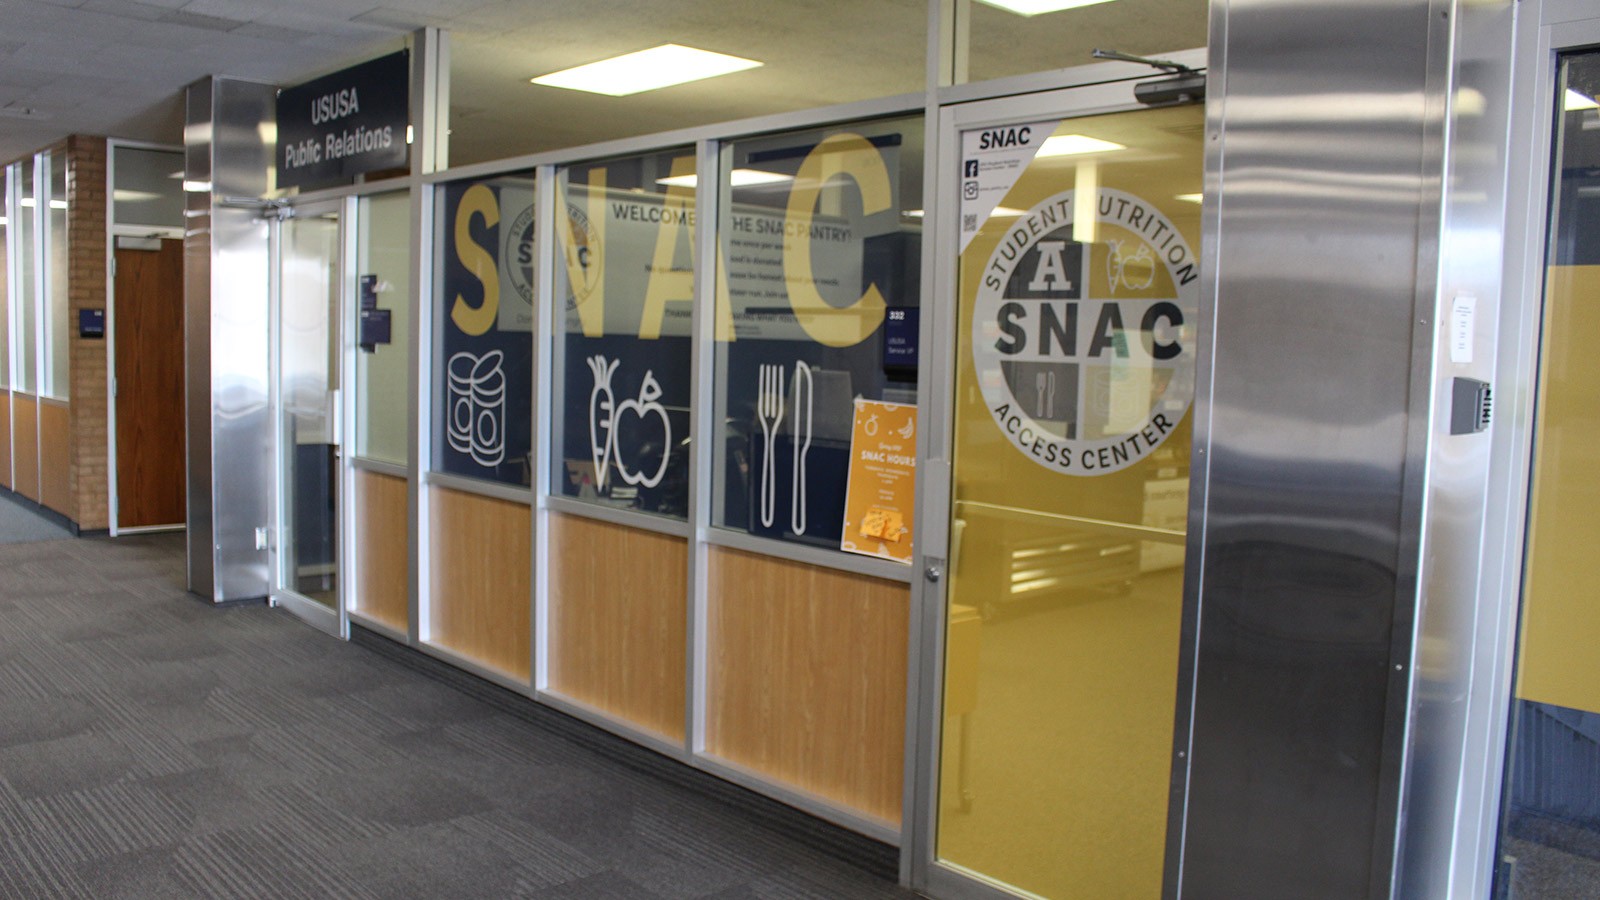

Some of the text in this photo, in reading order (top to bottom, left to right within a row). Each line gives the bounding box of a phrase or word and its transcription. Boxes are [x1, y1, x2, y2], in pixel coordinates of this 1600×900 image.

[312, 87, 359, 125] USUSA
[285, 125, 392, 169] Public Relations
[979, 126, 1031, 150] SNAC
[612, 203, 695, 227] WELCOME
[733, 217, 754, 232] HE
[756, 219, 794, 237] SNAC
[986, 195, 1198, 291] STUDENT UTRITION
[889, 310, 905, 320] 332
[994, 301, 1184, 360] SNAC
[994, 403, 1173, 470] ACCESS CENTER
[860, 449, 917, 468] SNAC HOURS
